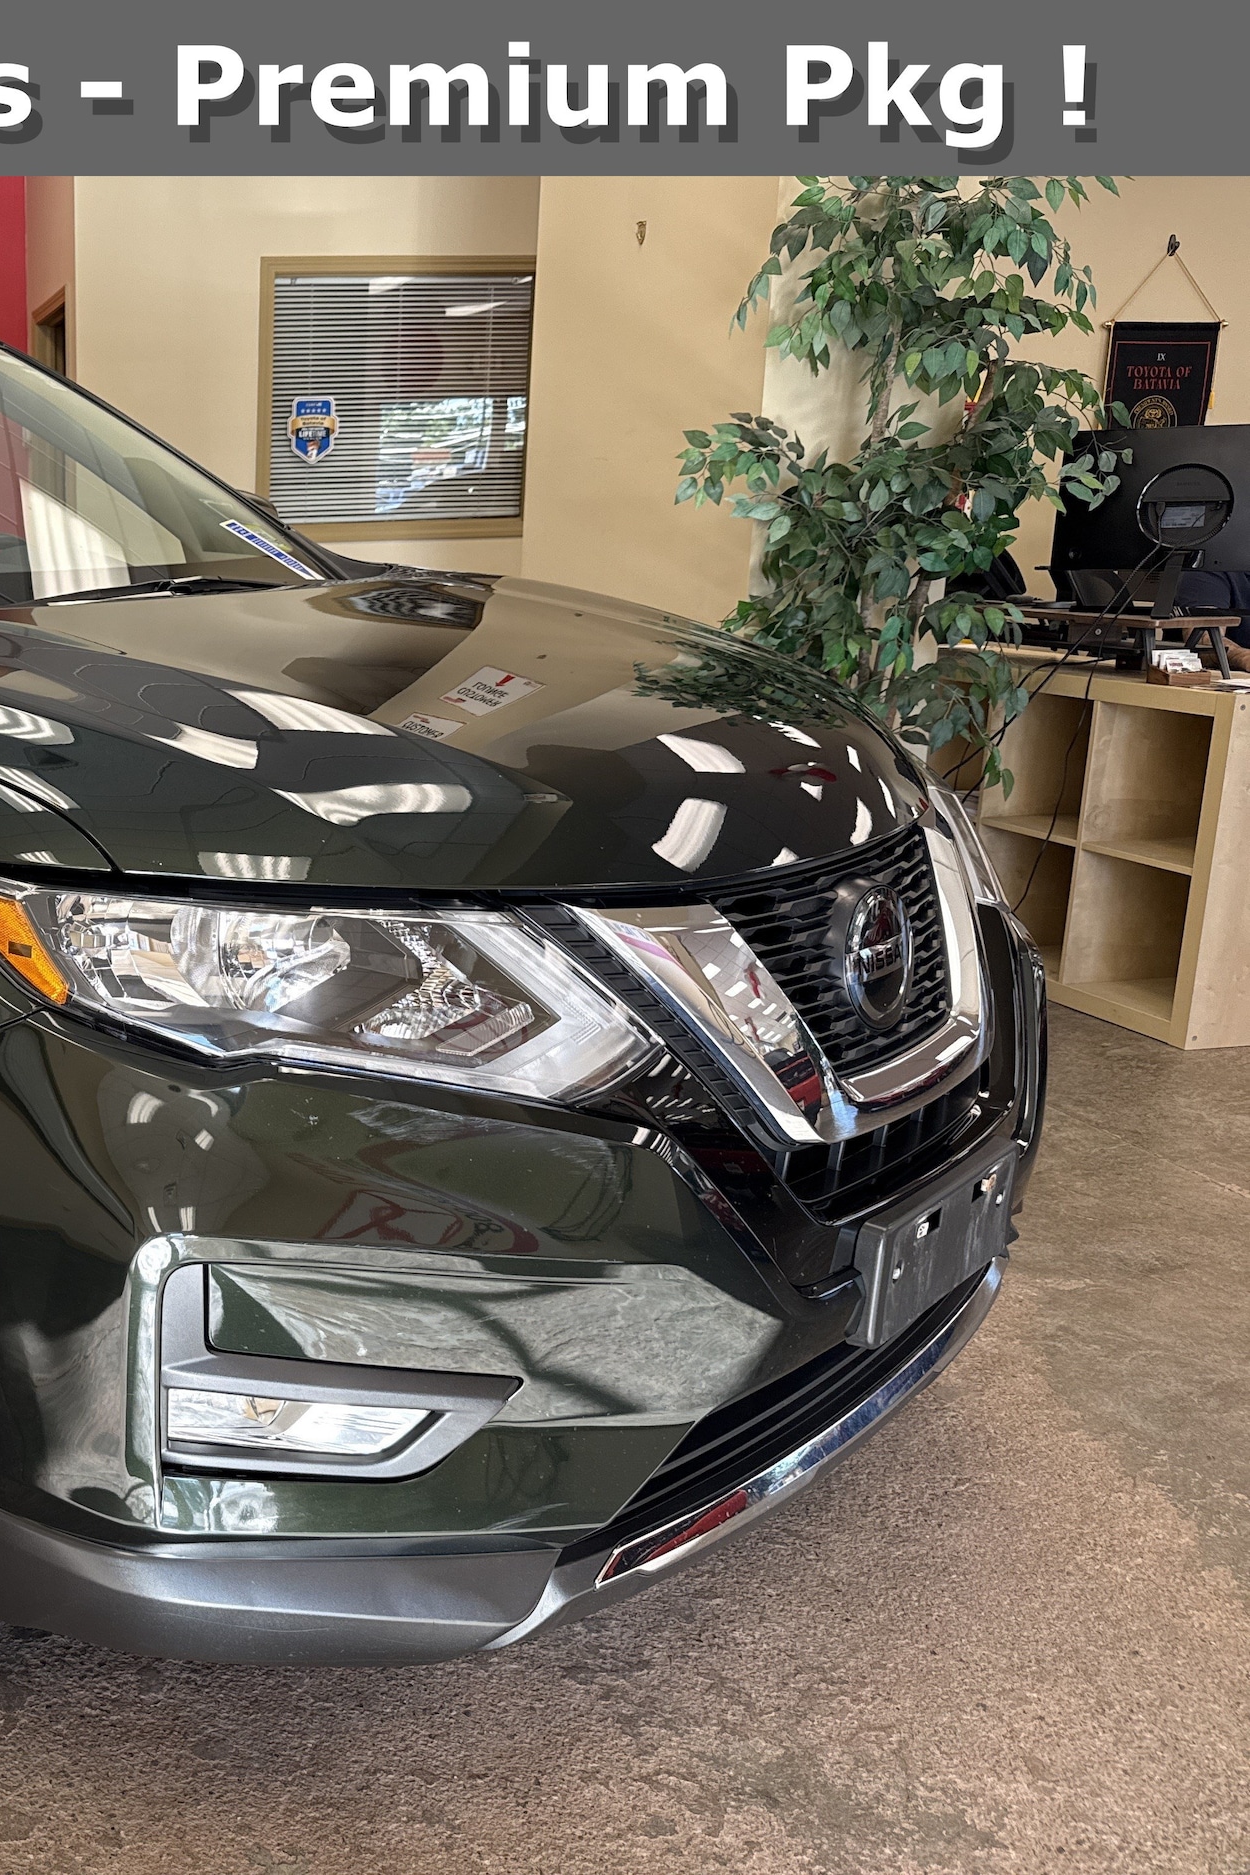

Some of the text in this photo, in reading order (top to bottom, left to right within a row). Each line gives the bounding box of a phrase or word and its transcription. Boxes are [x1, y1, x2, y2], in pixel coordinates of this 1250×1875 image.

[1157, 353, 1166, 361] IX
[1127, 366, 1193, 378] TOYOTA OF
[1133, 379, 1181, 390] BATAVIA
[858, 943, 903, 976] NISSA
